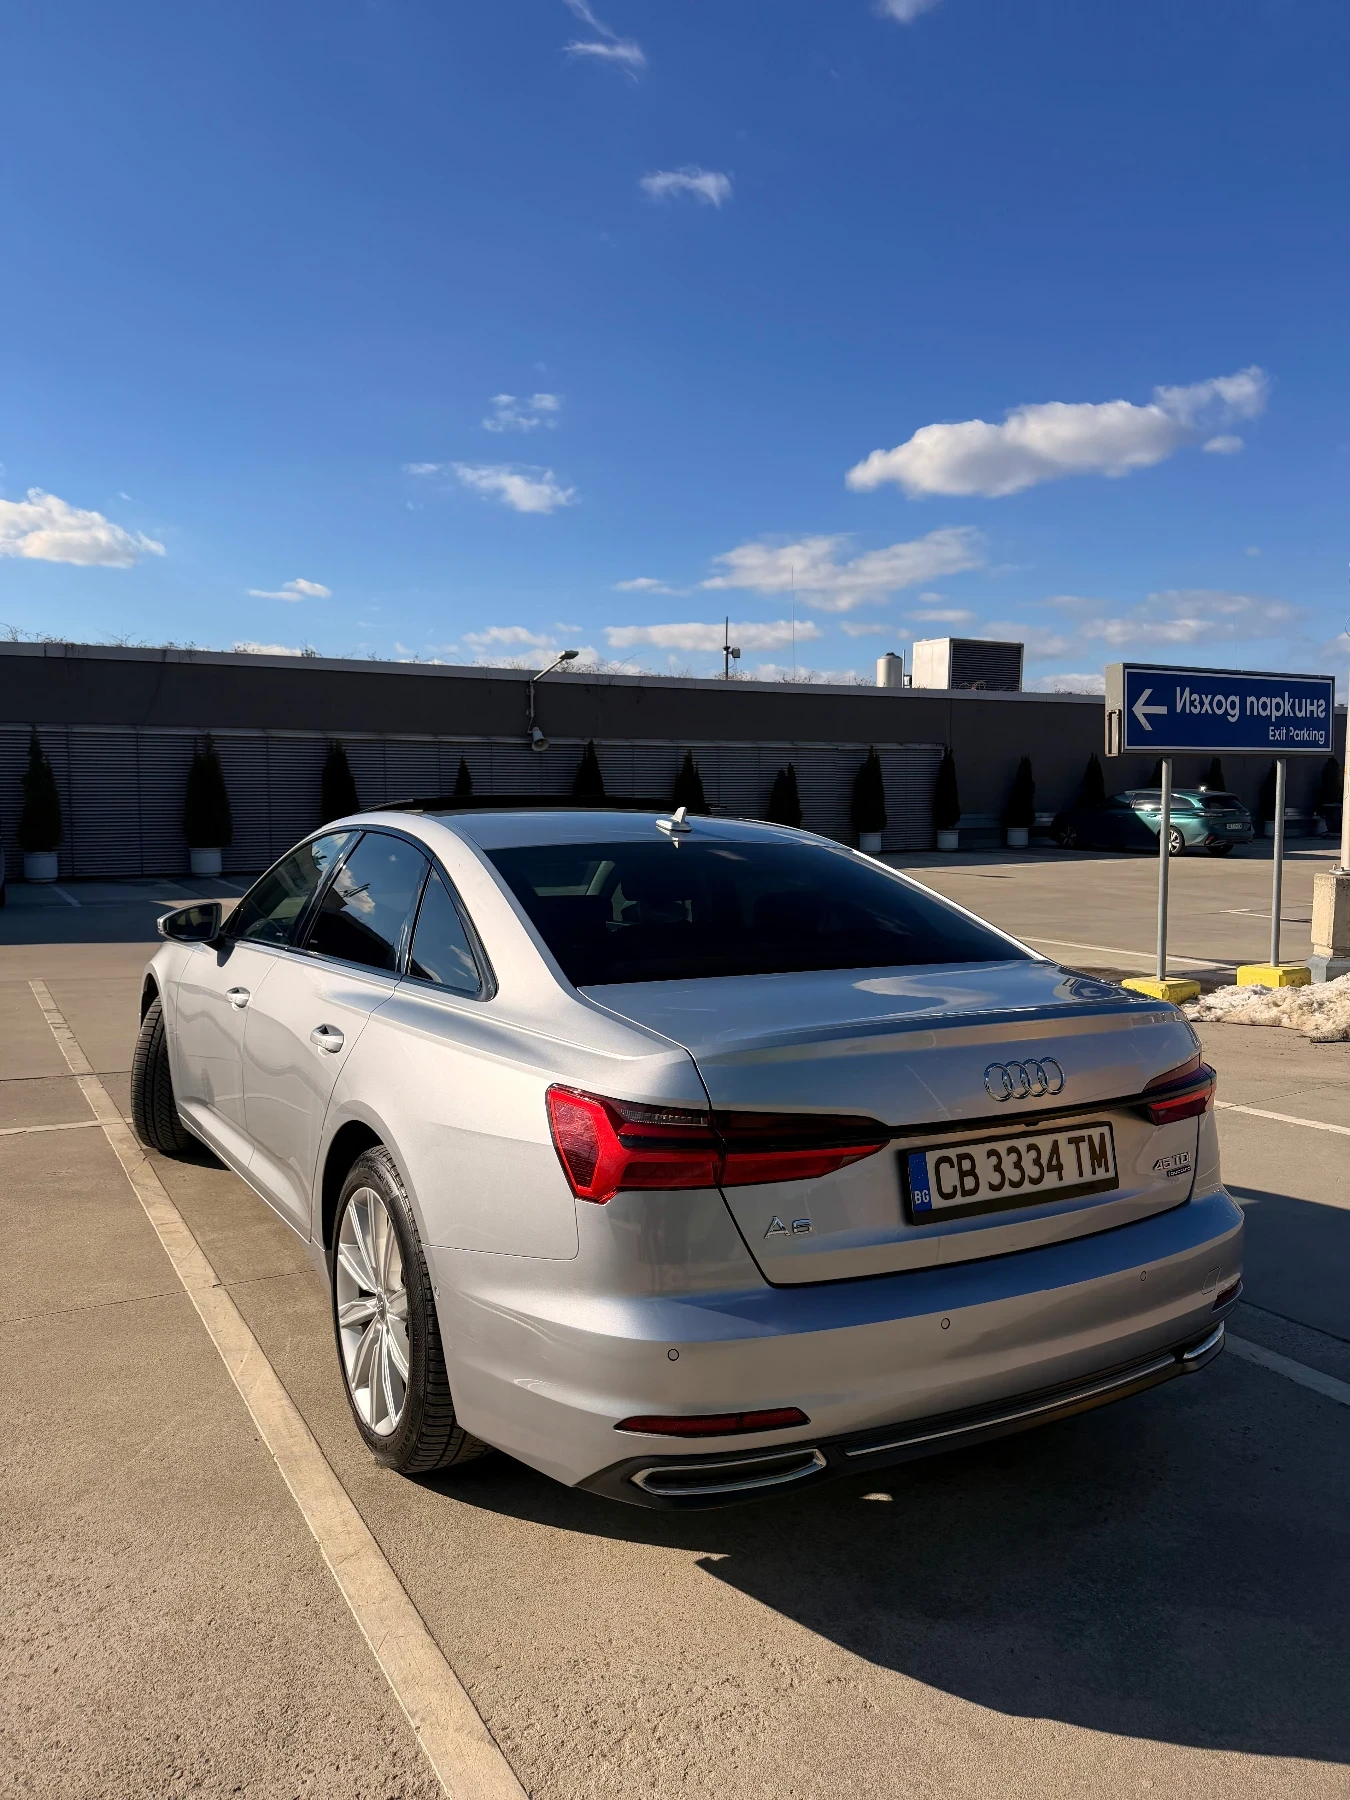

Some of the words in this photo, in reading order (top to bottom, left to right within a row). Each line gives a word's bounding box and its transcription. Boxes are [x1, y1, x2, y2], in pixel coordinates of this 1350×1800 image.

[1176, 687, 1239, 722] Изход
[1246, 692, 1326, 721] паркинг
[1269, 727, 1286, 741] Exit
[1289, 727, 1325, 744] Parking
[934, 1153, 980, 1200] CB
[986, 1139, 1064, 1192] 3334
[1067, 1132, 1110, 1178] TM
[1153, 1157, 1171, 1171] 45
[1172, 1151, 1191, 1165] TDI
[914, 1190, 930, 1205] BG
[764, 1215, 813, 1239] A6
